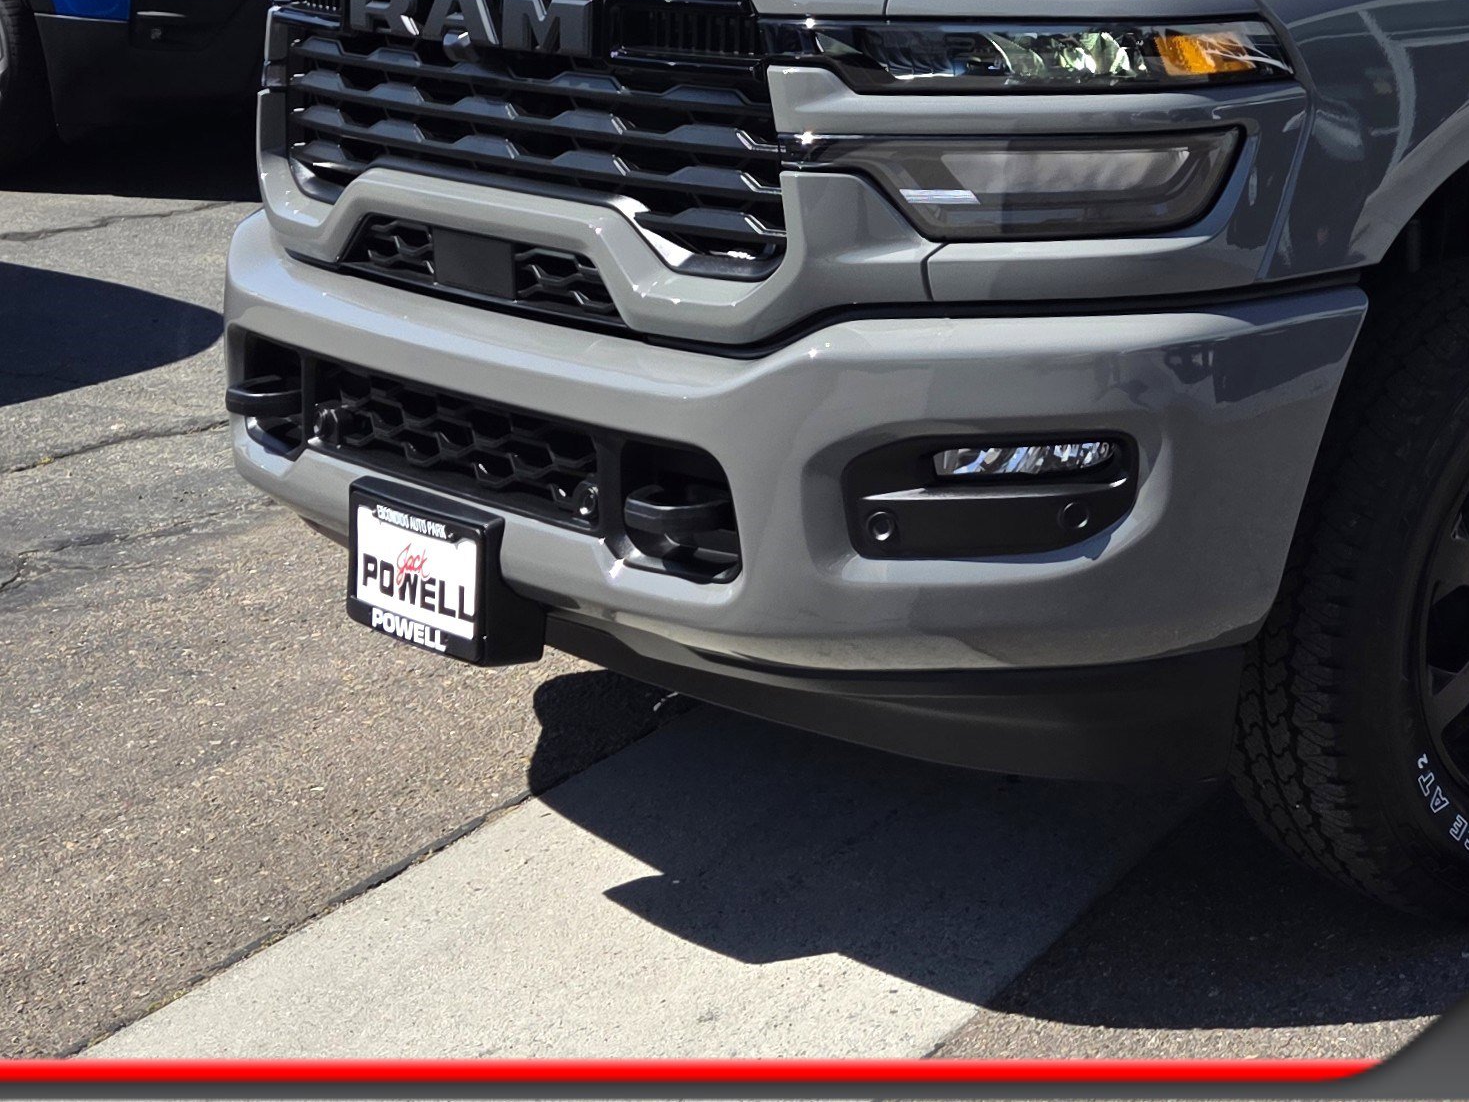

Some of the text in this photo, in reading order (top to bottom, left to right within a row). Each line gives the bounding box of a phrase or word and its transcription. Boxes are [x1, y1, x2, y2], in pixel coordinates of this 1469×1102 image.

[409, 516, 428, 534] AUTO
[427, 521, 447, 539] PARK
[362, 553, 476, 623] POWELL
[395, 543, 430, 592] Jack
[371, 607, 447, 652] POWELL
